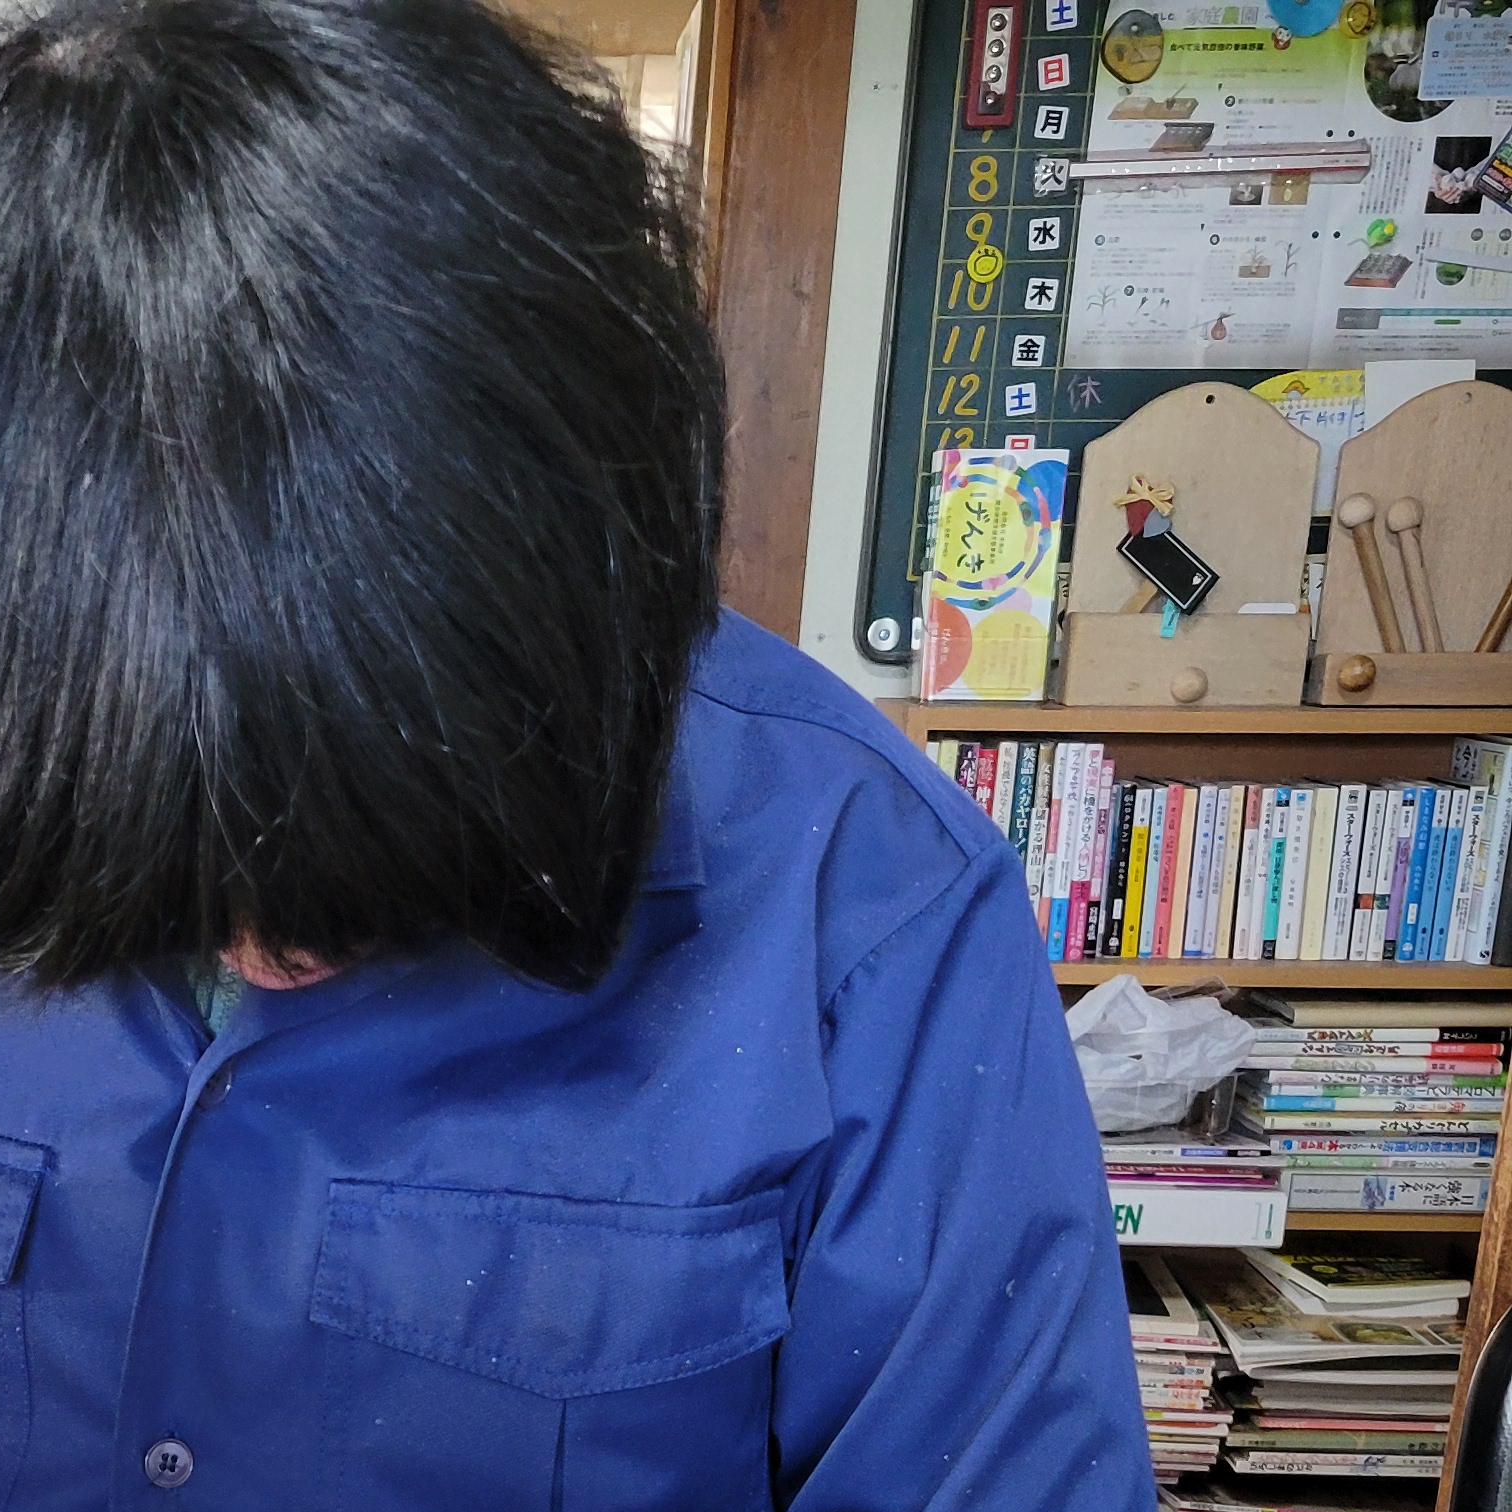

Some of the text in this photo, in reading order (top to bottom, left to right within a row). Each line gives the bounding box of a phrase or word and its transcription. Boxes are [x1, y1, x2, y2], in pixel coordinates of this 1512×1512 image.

[1050, 0, 1074, 25] 土
[1043, 58, 1064, 84] 日
[1040, 109, 1064, 134] 月
[968, 155, 1064, 202] 8 火
[1032, 220, 1057, 245] 水
[947, 269, 1054, 311] 10 木
[943, 325, 1041, 364] 11 金
[938, 373, 981, 416] 12
[1009, 386, 1033, 411] 土
[956, 492, 991, 574] げんき
